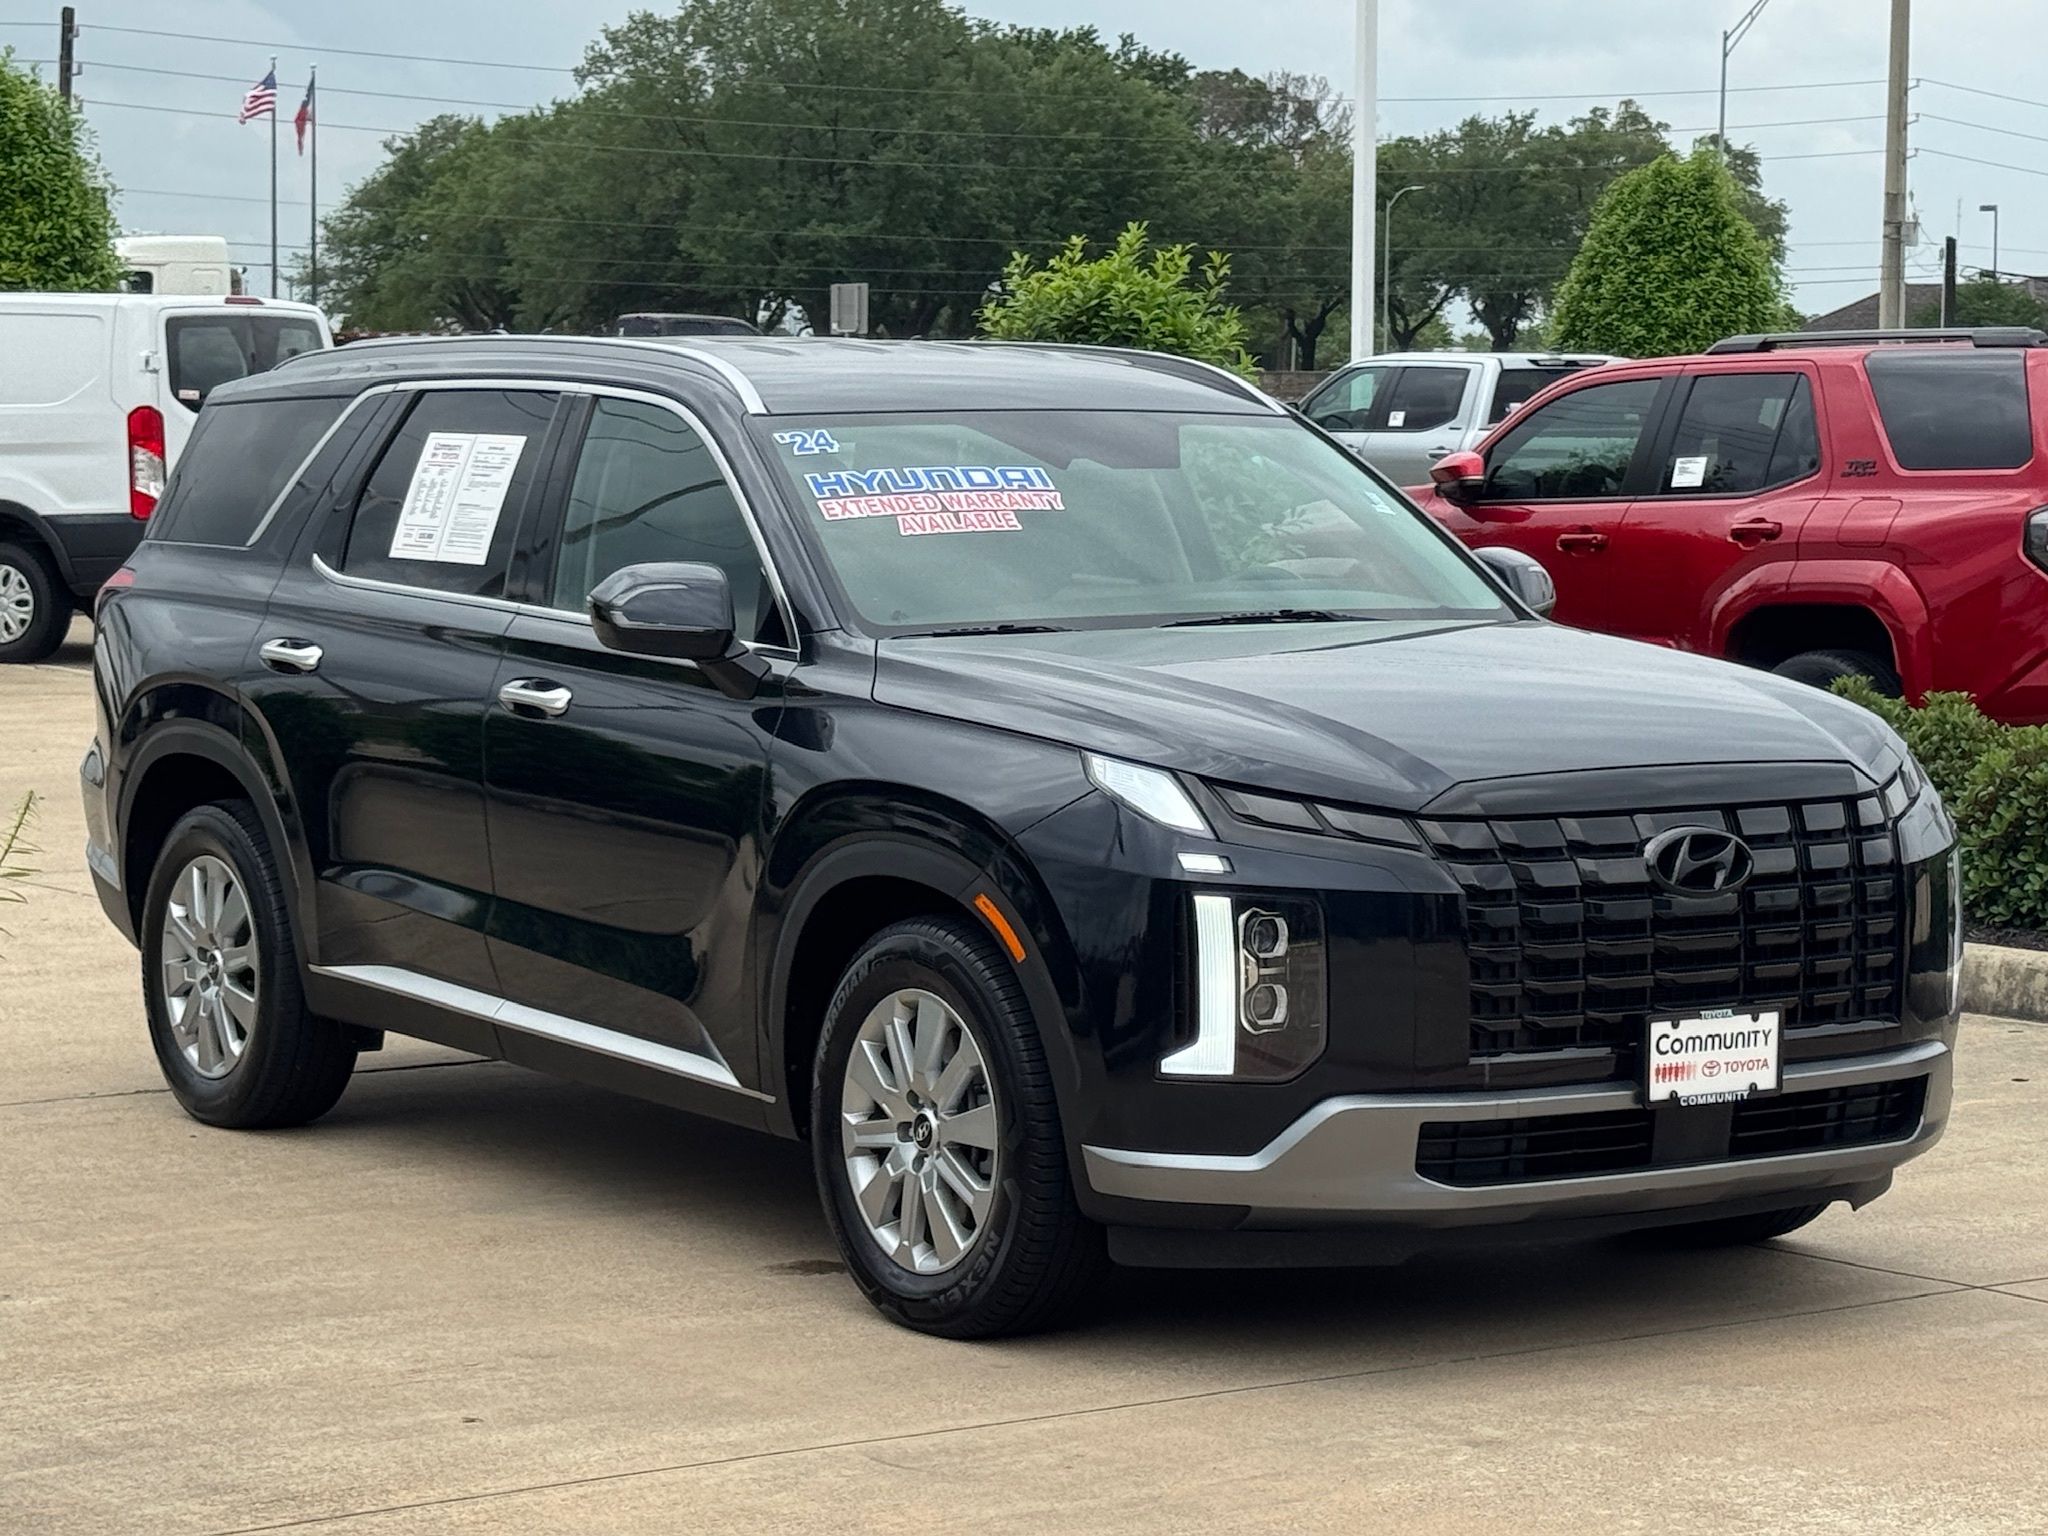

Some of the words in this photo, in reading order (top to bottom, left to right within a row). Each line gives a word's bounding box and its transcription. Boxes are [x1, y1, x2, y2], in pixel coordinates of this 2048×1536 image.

[804, 465, 1056, 498] HYUNDAI
[821, 495, 938, 519] EXTENDED
[942, 492, 1064, 511] WARRANTY
[901, 511, 1019, 534] AVAILABLE
[1700, 1009, 1733, 1019] TOYOTA
[1723, 1058, 1770, 1074] TOYOTA
[1680, 1091, 1749, 1107] COMMUNITY
